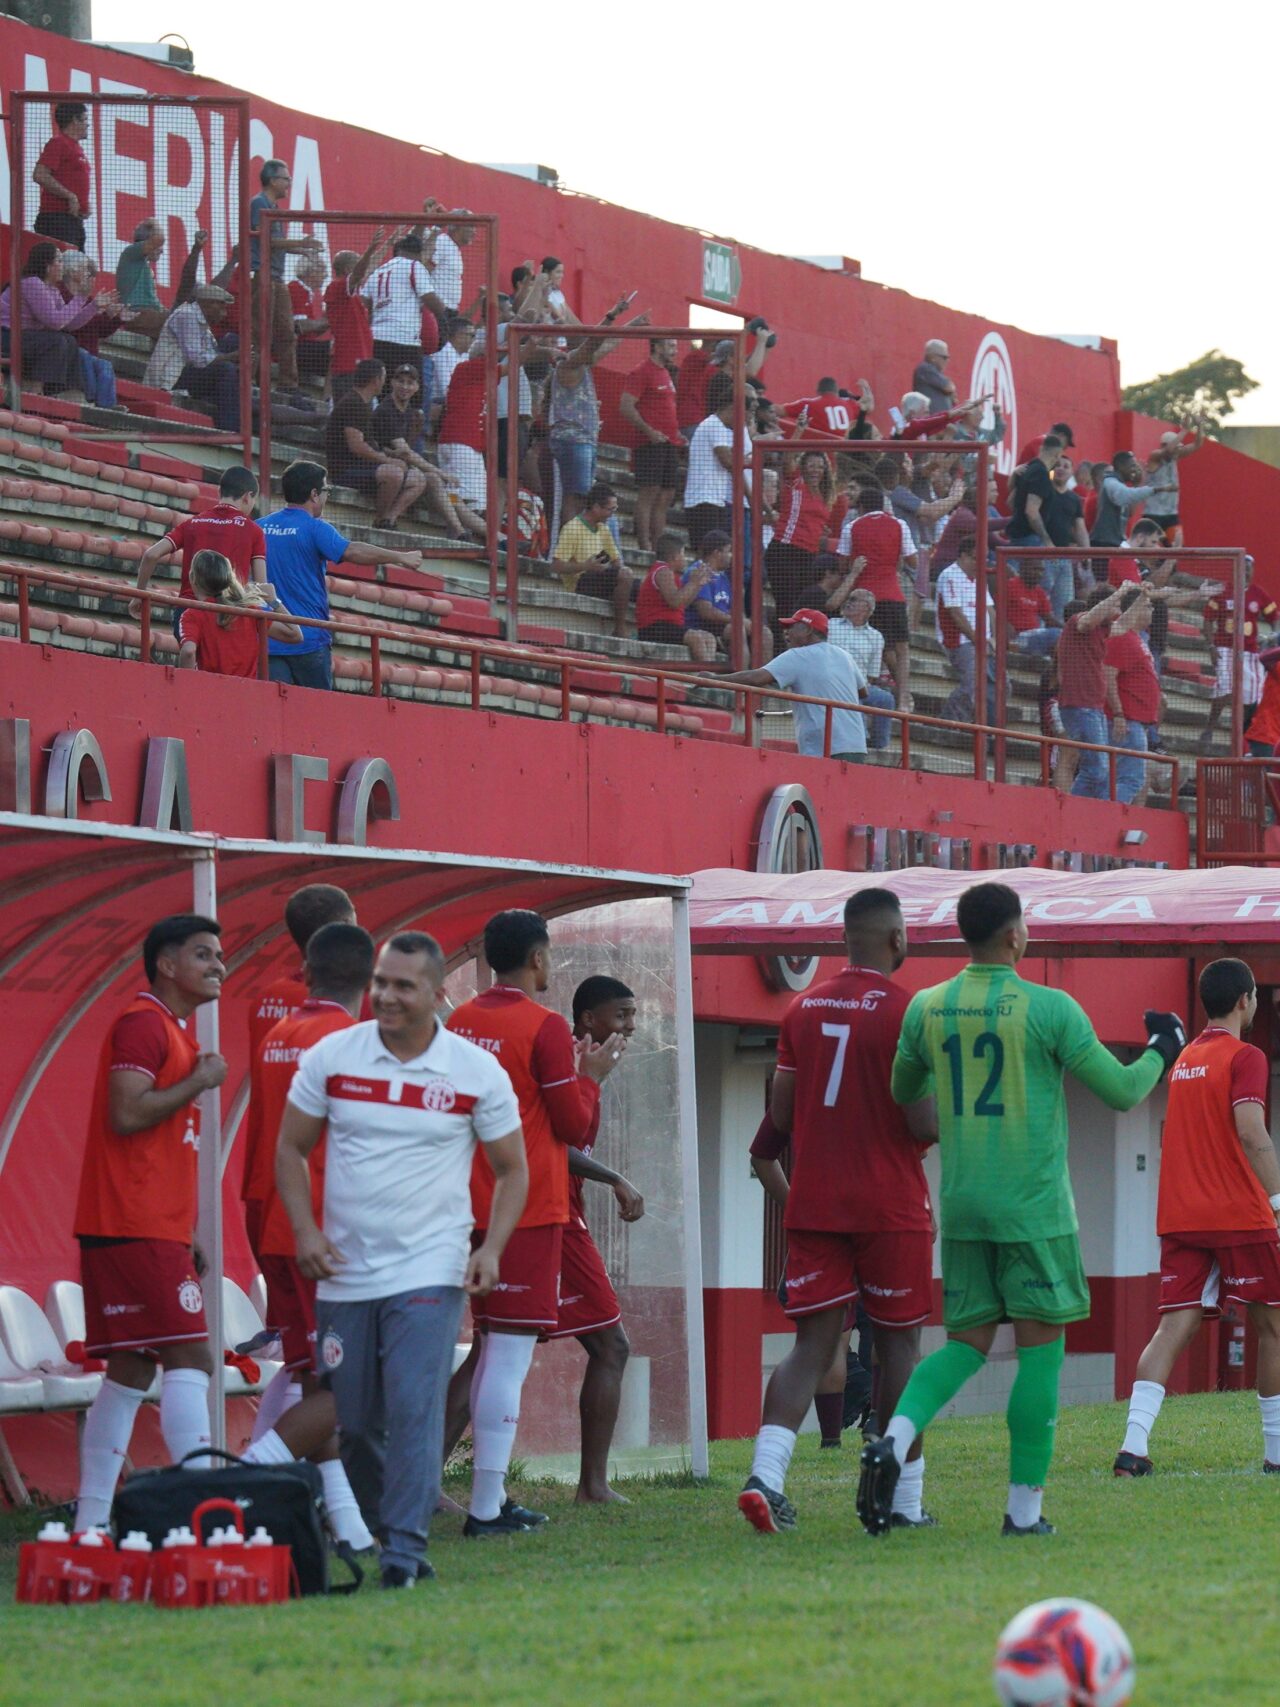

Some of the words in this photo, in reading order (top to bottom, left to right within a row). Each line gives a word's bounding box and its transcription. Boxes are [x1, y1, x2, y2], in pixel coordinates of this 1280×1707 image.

[0, 53, 334, 290] MERICA
[824, 405, 849, 430] 10
[860, 999, 878, 1011] RJ
[995, 1006, 1012, 1016] RJ
[822, 1022, 850, 1107] 7
[942, 1032, 1005, 1116] 12
